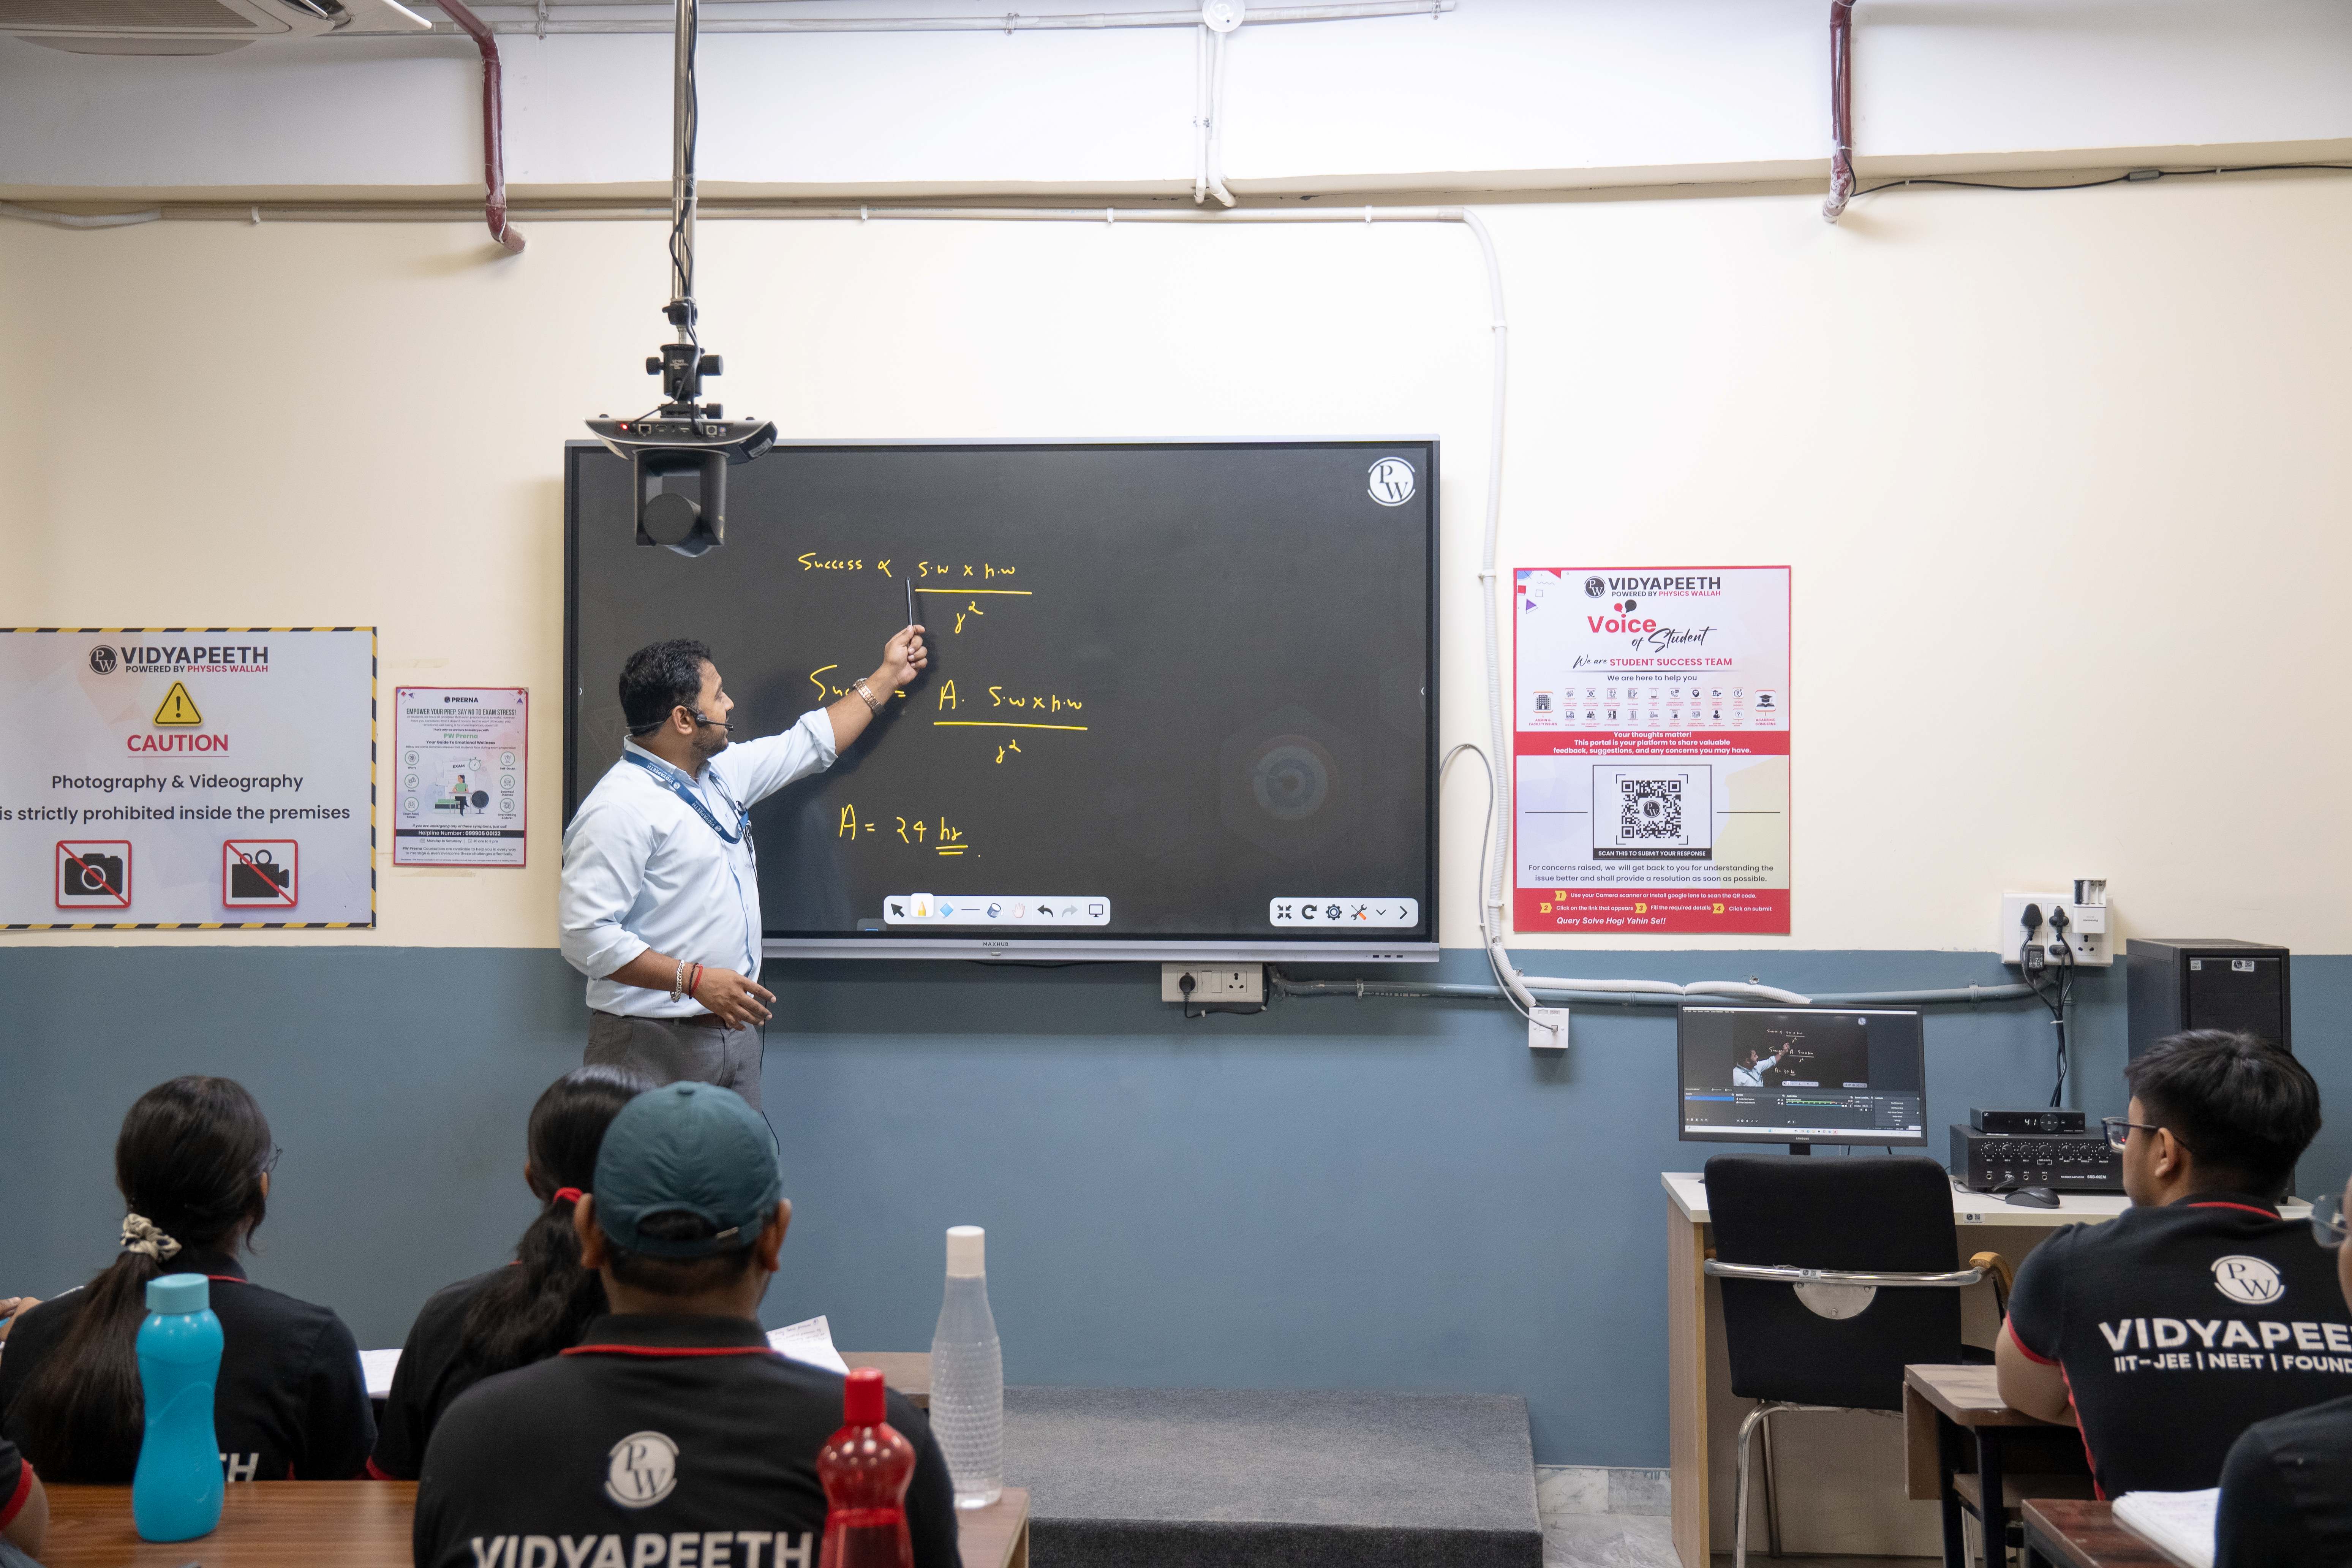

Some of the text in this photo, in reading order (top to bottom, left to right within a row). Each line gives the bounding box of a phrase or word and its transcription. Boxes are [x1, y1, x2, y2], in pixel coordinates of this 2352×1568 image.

[798, 552, 863, 571] Success
[1608, 577, 1721, 590] VIDYAPEETH
[1587, 613, 1657, 633] Voice
[1631, 626, 1717, 653] of Student
[121, 646, 268, 664] VIDYAPEETH
[1573, 654, 1591, 669] We
[127, 734, 228, 752] CAUTION
[52, 774, 303, 793] Photography & Videography
[0, 805, 350, 825] is strictly prohibited inside the premises
[1704, 865, 1759, 873] understanding
[1557, 917, 1581, 925] Query
[1606, 917, 1625, 926] Hogi
[2098, 1318, 2352, 1352] VIDYAPEE
[2115, 1353, 2191, 1372] IIT-JEE
[2209, 1353, 2263, 1368] NEET
[471, 1532, 813, 1568] VIDYAPEETH
